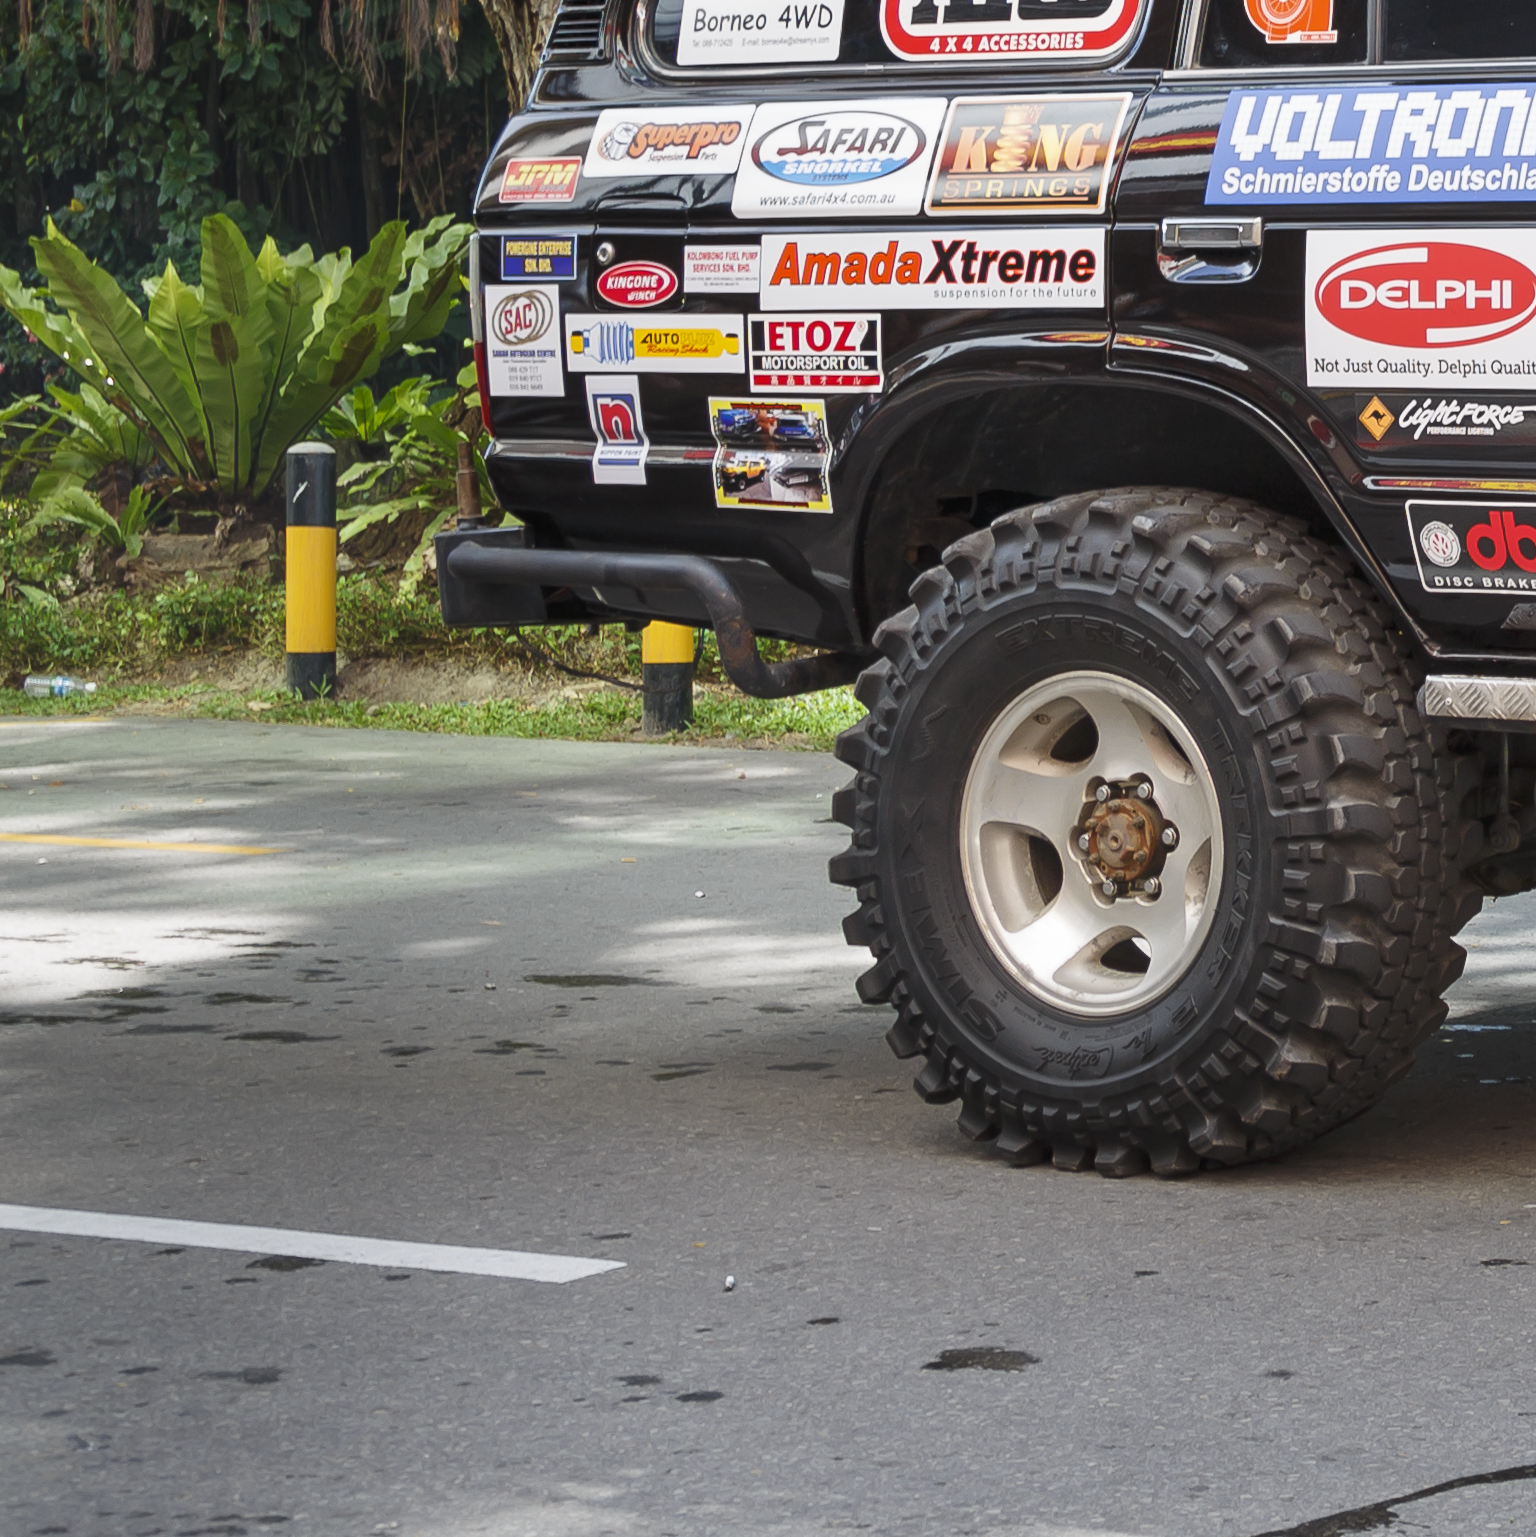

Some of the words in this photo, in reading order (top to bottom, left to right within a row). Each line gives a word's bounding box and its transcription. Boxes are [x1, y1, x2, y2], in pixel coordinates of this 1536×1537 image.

[693, 8, 767, 32] Borneo
[778, 3, 833, 29] 4WD
[929, 37, 943, 52] 4
[960, 36, 973, 51] 4
[977, 32, 1084, 51] ACCESSORIES
[777, 120, 907, 156] SAFARI
[506, 163, 578, 186] JPM
[782, 160, 883, 175] SNORKEL
[942, 177, 1091, 199] SPRINGS
[1222, 165, 1401, 195] Schmierstoffe
[759, 192, 896, 207] www.safari4x4.com.au
[725, 251, 739, 261] FUEL
[606, 275, 659, 290] KINGONE
[627, 290, 657, 301] WINCH
[933, 288, 1007, 300] suspension
[1009, 287, 1029, 298] for
[1032, 287, 1053, 298] the
[1056, 286, 1097, 298] future
[1339, 279, 1512, 309] DELPHI
[504, 303, 532, 336] SAC
[768, 320, 857, 352] ETOZ
[647, 345, 679, 356] Racing
[681, 344, 709, 354] Shock
[762, 356, 845, 370] MOTORSPORT
[848, 356, 869, 370] OIL
[1314, 358, 1339, 375] Not
[1343, 358, 1373, 375] Just
[1377, 359, 1434, 378] Quality.
[1438, 359, 1487, 378] Delphi
[1427, 426, 1466, 435] PERFORMANCE
[1434, 576, 1473, 588] DISC
[995, 614, 1200, 703] EXTREME
[1207, 718, 1253, 989] TREKKER
